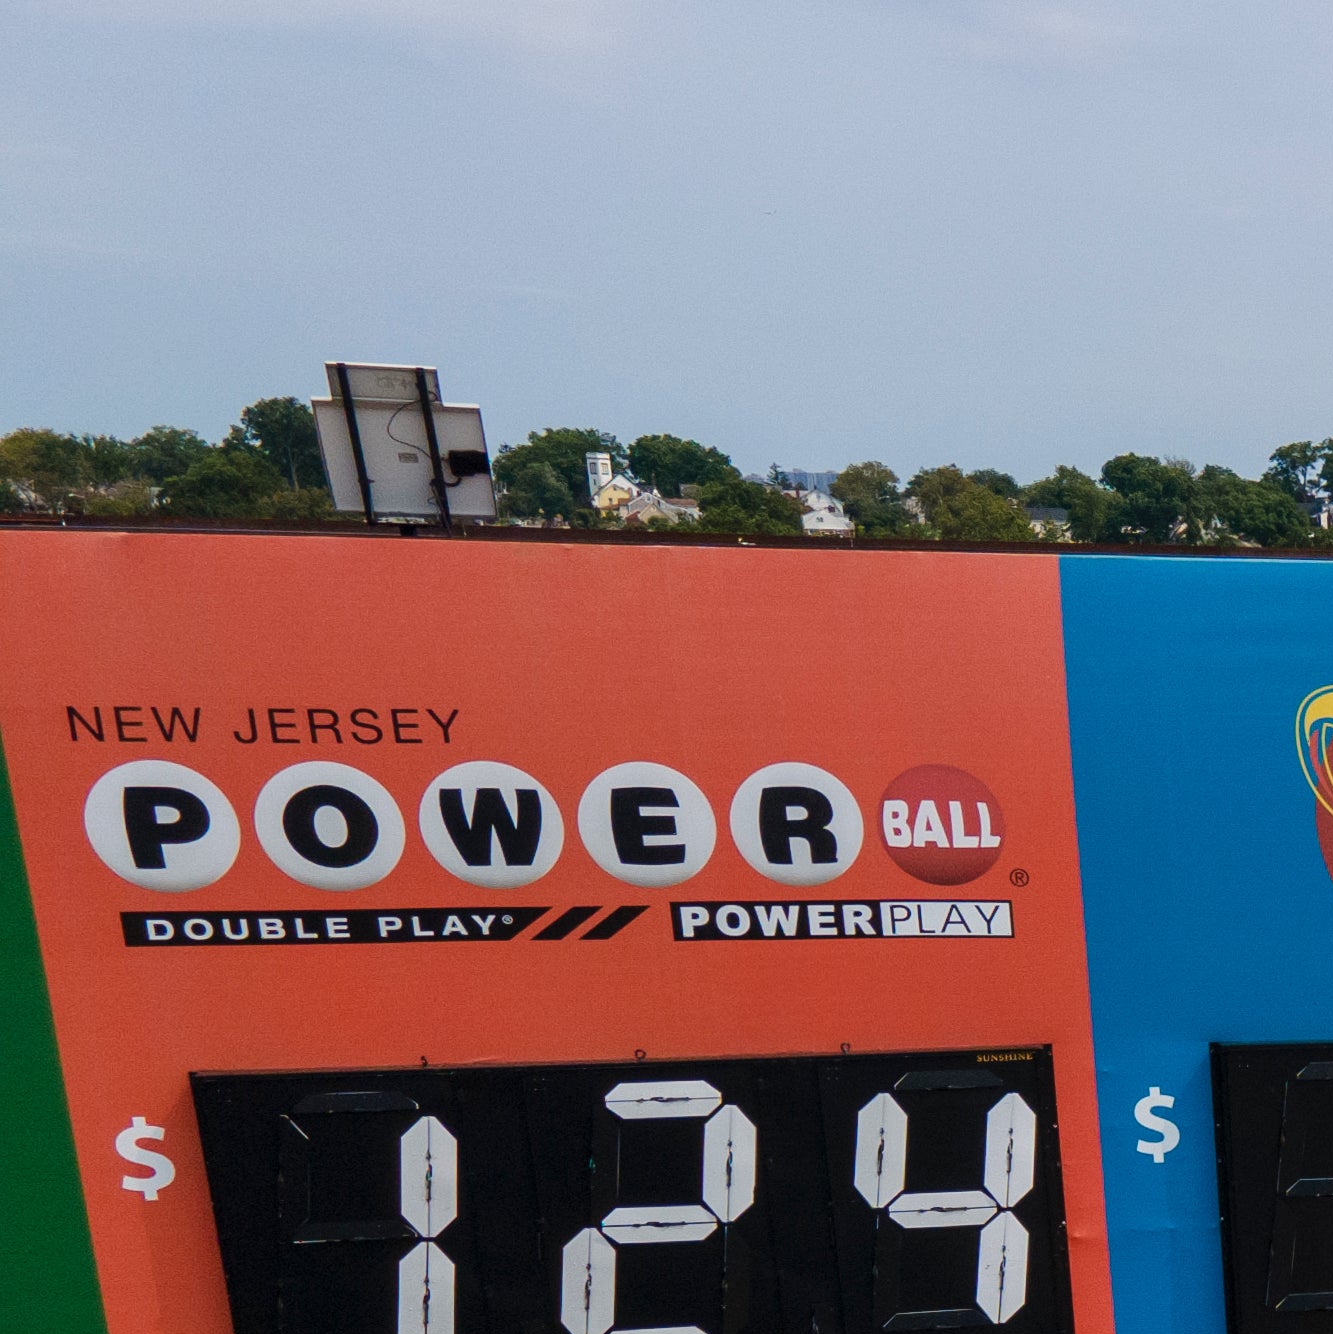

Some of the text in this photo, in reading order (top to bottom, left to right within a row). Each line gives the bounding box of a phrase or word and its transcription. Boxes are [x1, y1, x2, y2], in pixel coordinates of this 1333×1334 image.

[66, 706, 461, 744] NEW JERSEY
[146, 916, 350, 943] DOUBLE
[976, 1052, 1033, 1063] SUNSHINE
[1133, 1086, 1181, 1164] $
[116, 1117, 176, 1201] $
